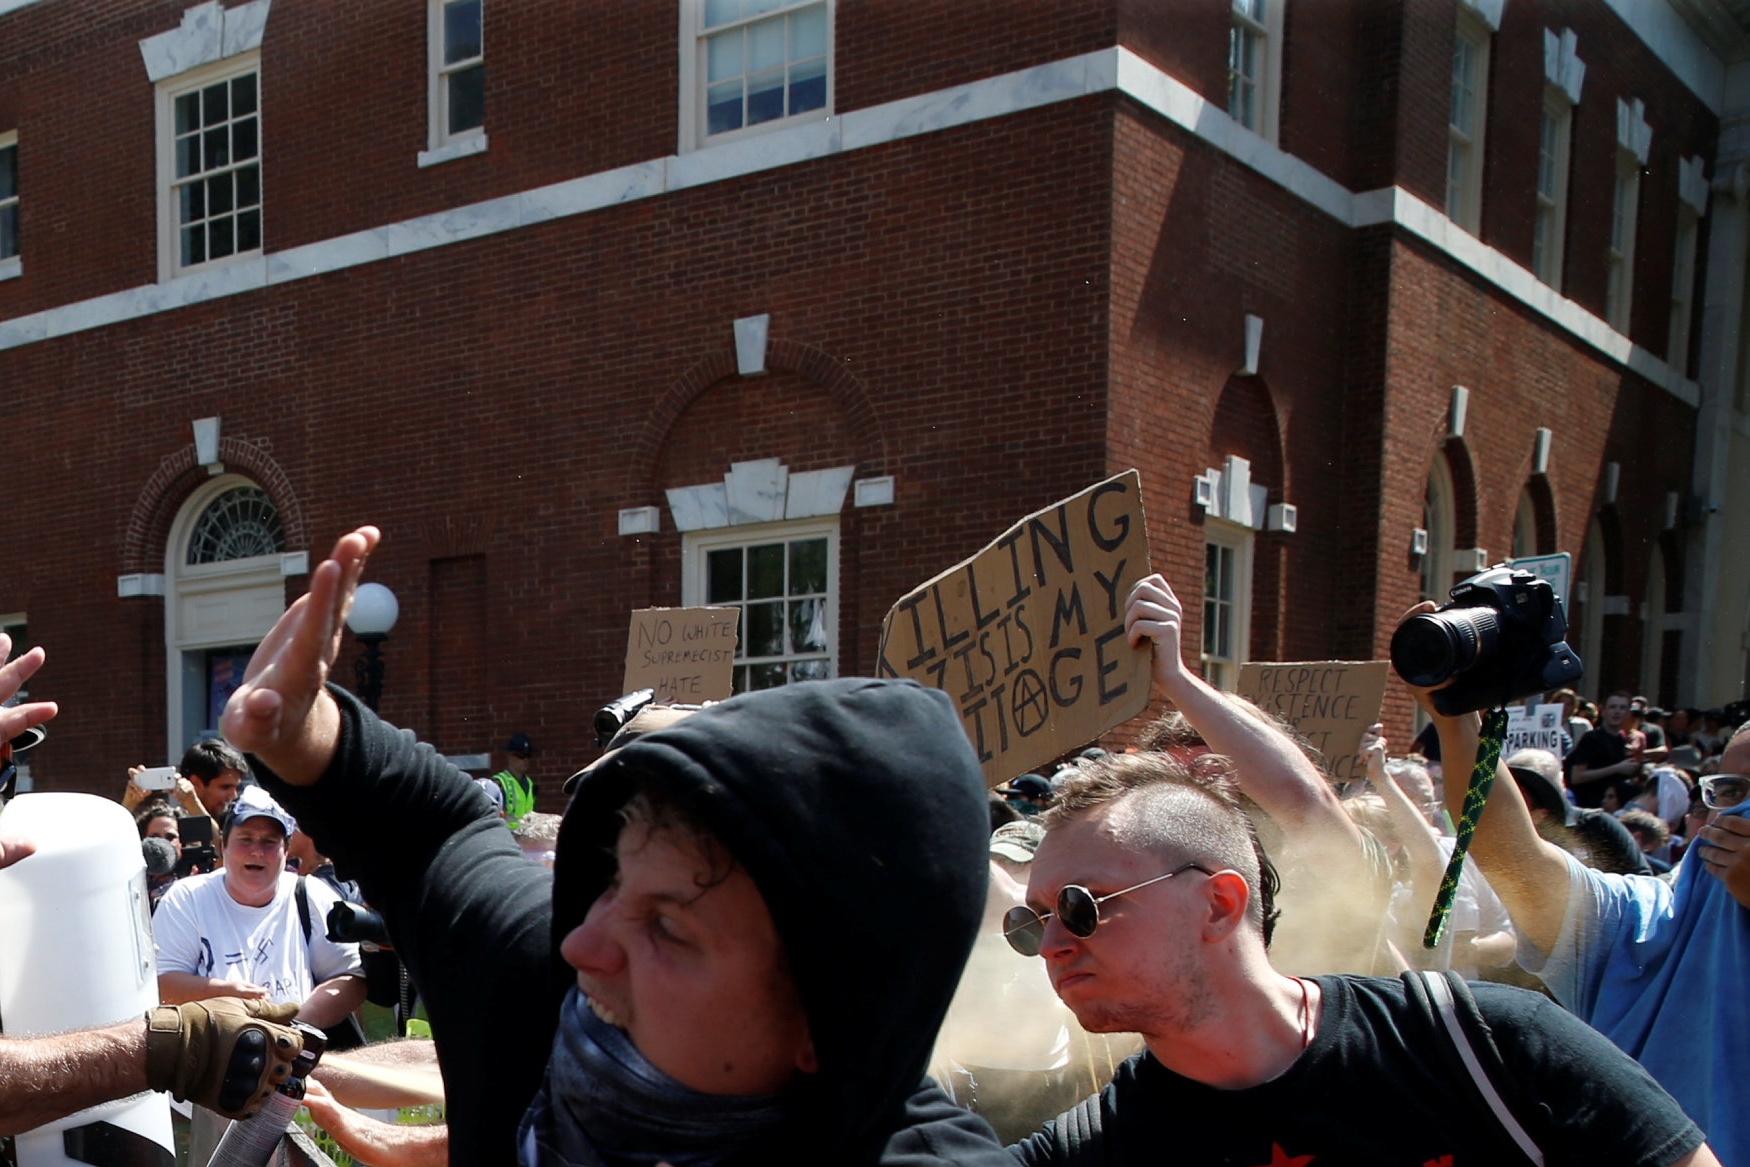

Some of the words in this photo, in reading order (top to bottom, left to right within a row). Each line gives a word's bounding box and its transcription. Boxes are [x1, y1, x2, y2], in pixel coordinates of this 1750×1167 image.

[878, 481, 1130, 679] KILLING
[637, 617, 673, 649] NO
[681, 620, 731, 642] WHITE
[926, 631, 997, 705] ZIS
[997, 604, 1033, 677] IS
[1049, 558, 1128, 650] MY
[641, 648, 731, 669] SUPREMECIST
[659, 675, 702, 694] HATE
[962, 623, 1128, 765] ITAGE
[1258, 668, 1349, 694] RESPECT
[1508, 730, 1558, 750] PARKING
